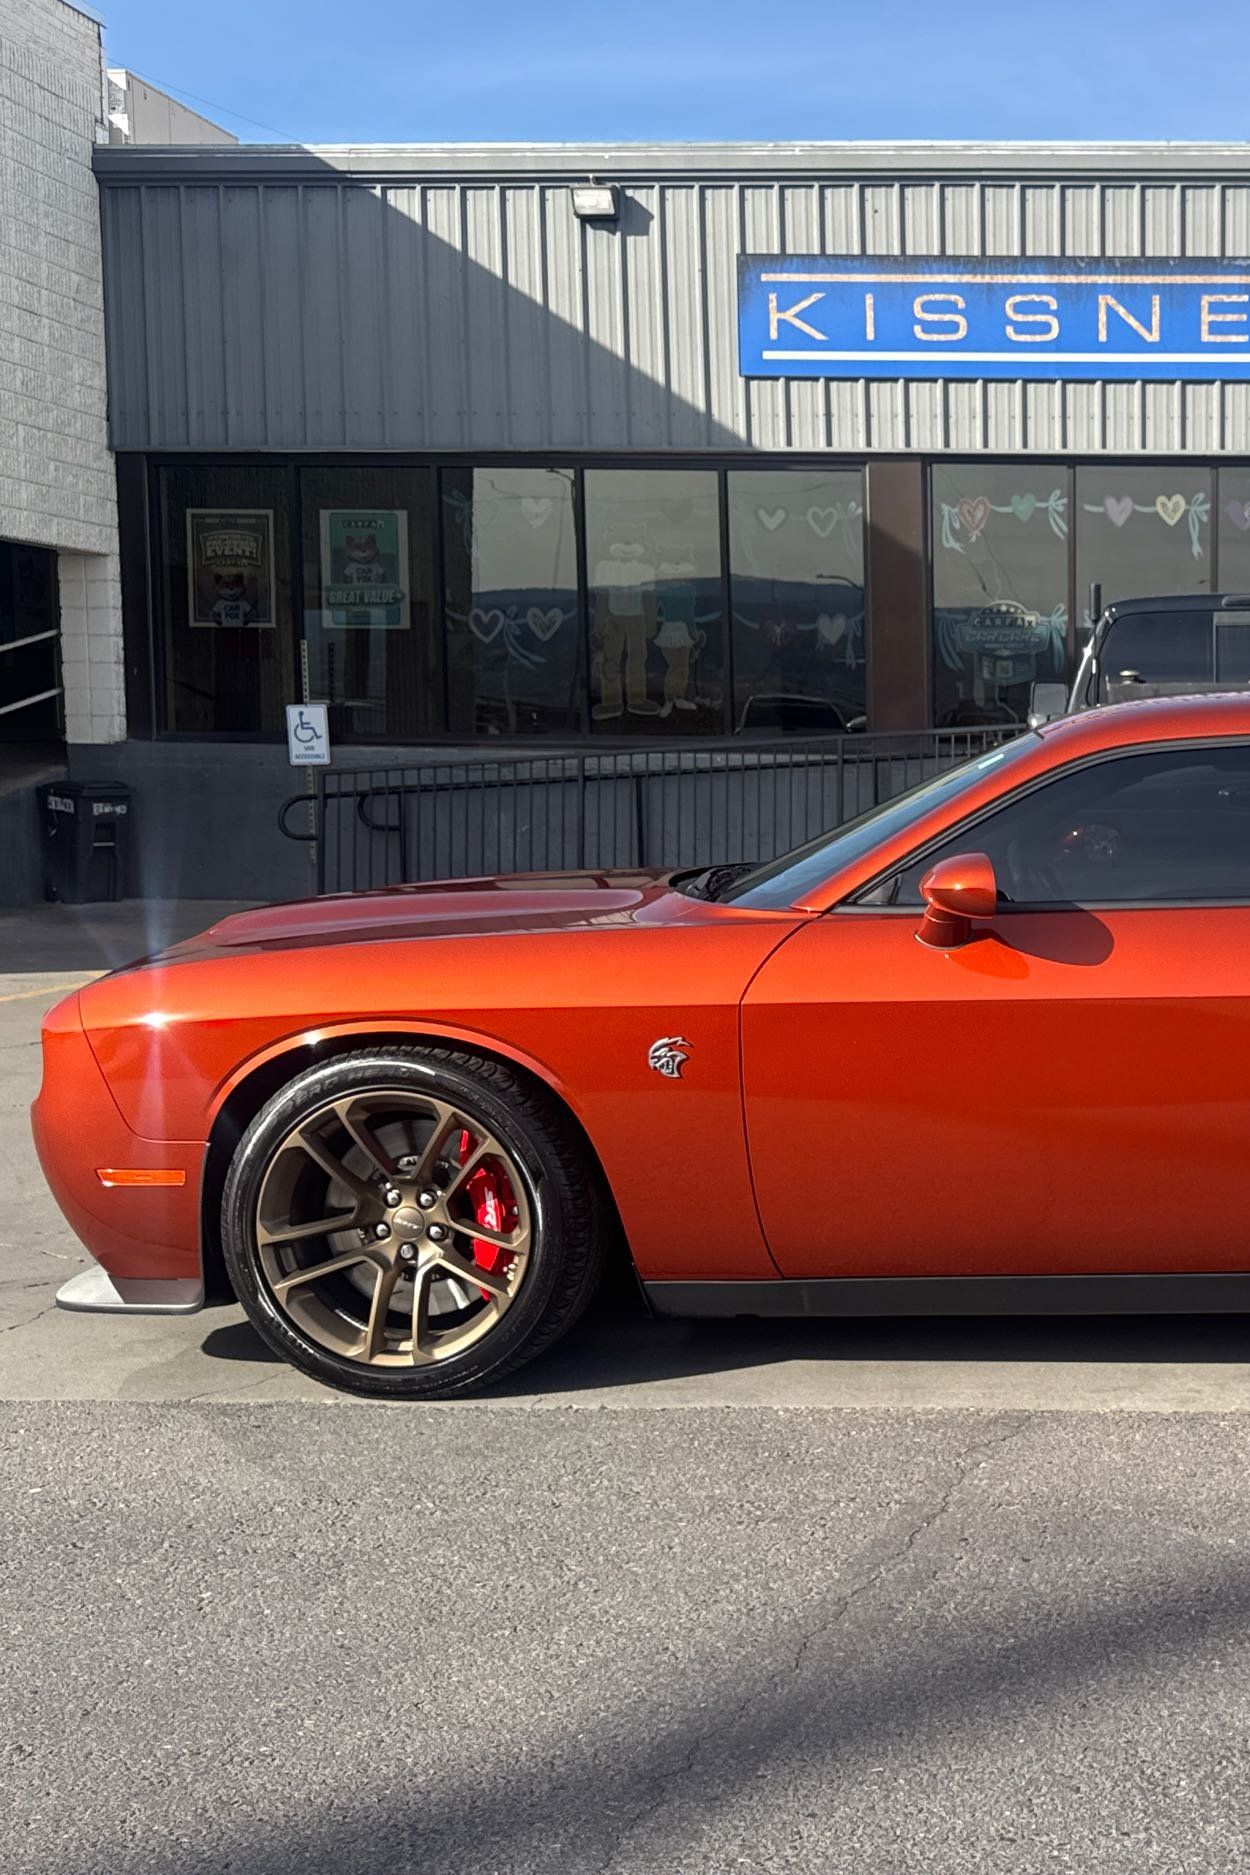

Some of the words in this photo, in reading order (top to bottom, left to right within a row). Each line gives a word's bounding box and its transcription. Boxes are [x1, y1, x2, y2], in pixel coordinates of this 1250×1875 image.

[328, 590, 361, 604] GREAT
[364, 589, 395, 603] VALUE
[974, 616, 1035, 629] CARFAX
